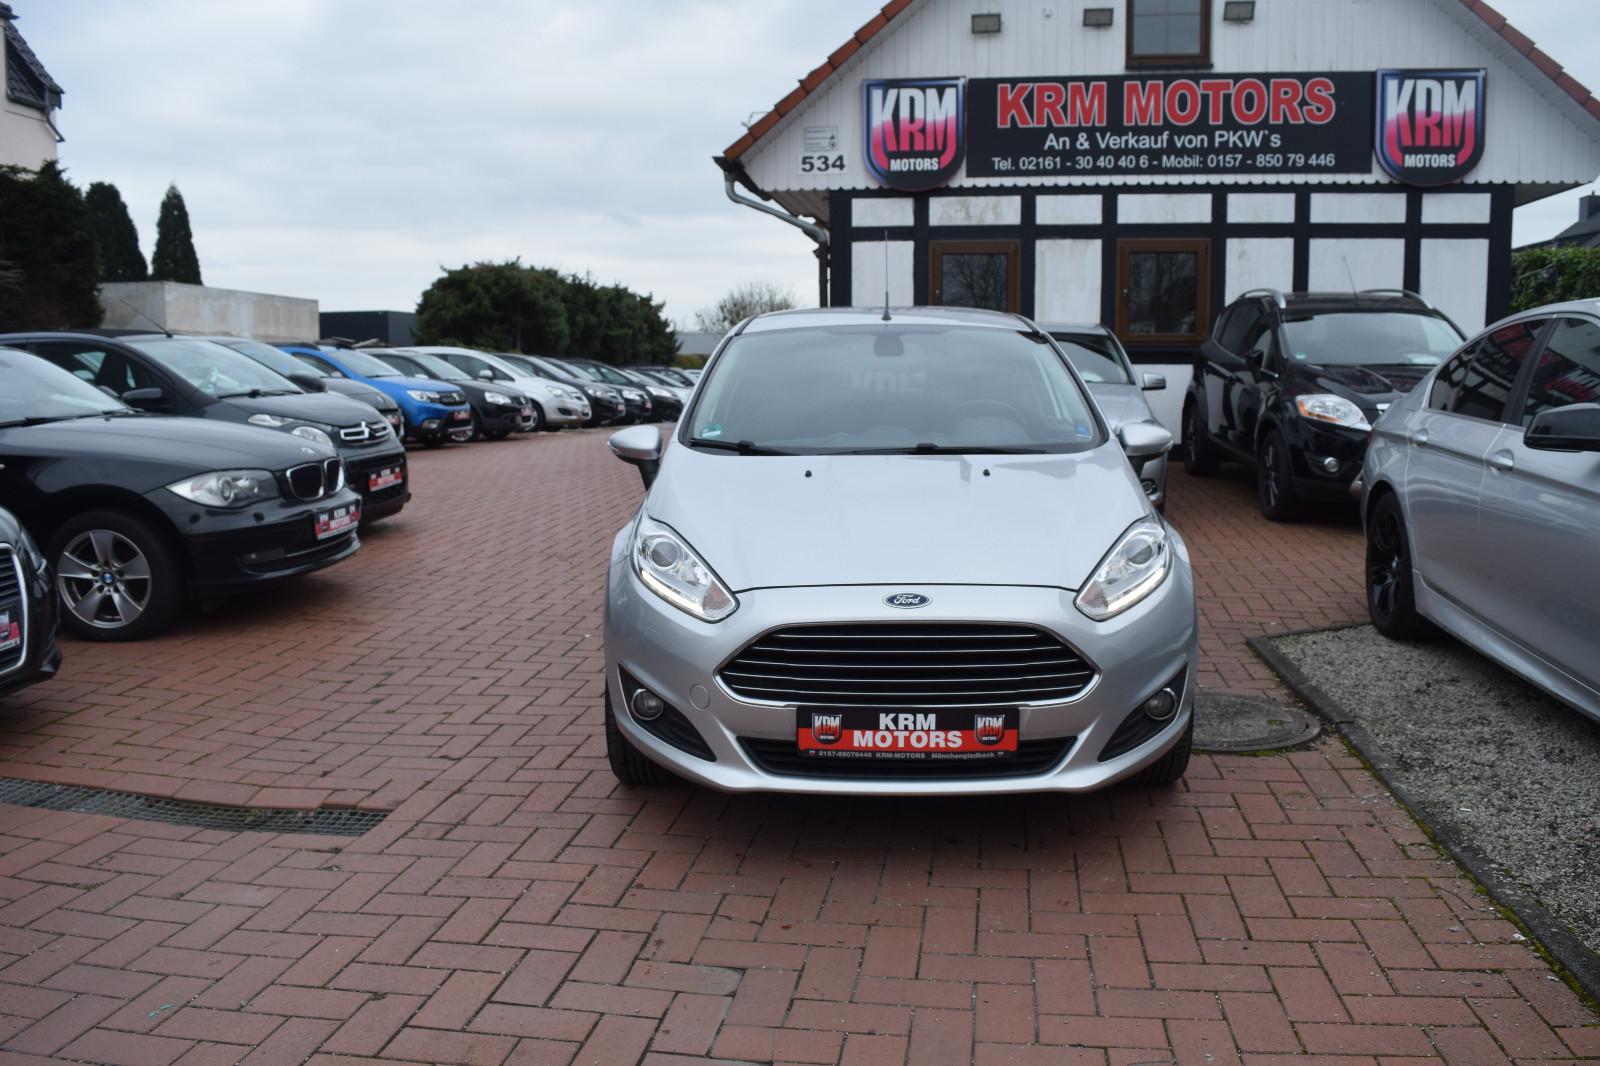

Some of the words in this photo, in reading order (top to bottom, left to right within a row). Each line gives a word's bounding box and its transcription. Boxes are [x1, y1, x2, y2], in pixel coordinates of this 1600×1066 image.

[997, 81, 1107, 128] KRM
[1123, 77, 1336, 126] MOTORS
[871, 87, 957, 169] KRM
[1386, 79, 1476, 166] KRM
[1044, 132, 1070, 150] An
[1076, 131, 1090, 149] &
[1096, 131, 1170, 149] Verkauf
[1174, 134, 1208, 149] von
[801, 154, 846, 172] 534
[890, 157, 939, 172] MOTORS
[992, 157, 1015, 170] Tel.
[1019, 156, 1062, 170] 02161
[1075, 155, 1093, 169] 30
[1096, 155, 1114, 169] 40
[1117, 154, 1135, 169] 40
[1139, 154, 1149, 168] 6
[1161, 154, 1203, 168] Mobil:
[1207, 154, 1243, 167] 0157
[1256, 153, 1283, 167] 850
[1287, 153, 1305, 167] 79
[1308, 153, 1335, 166] 446
[1404, 154, 1456, 168] MOTORS
[893, 594, 921, 604] Ford
[879, 713, 937, 731] KRM
[853, 730, 963, 748] MOTORS
